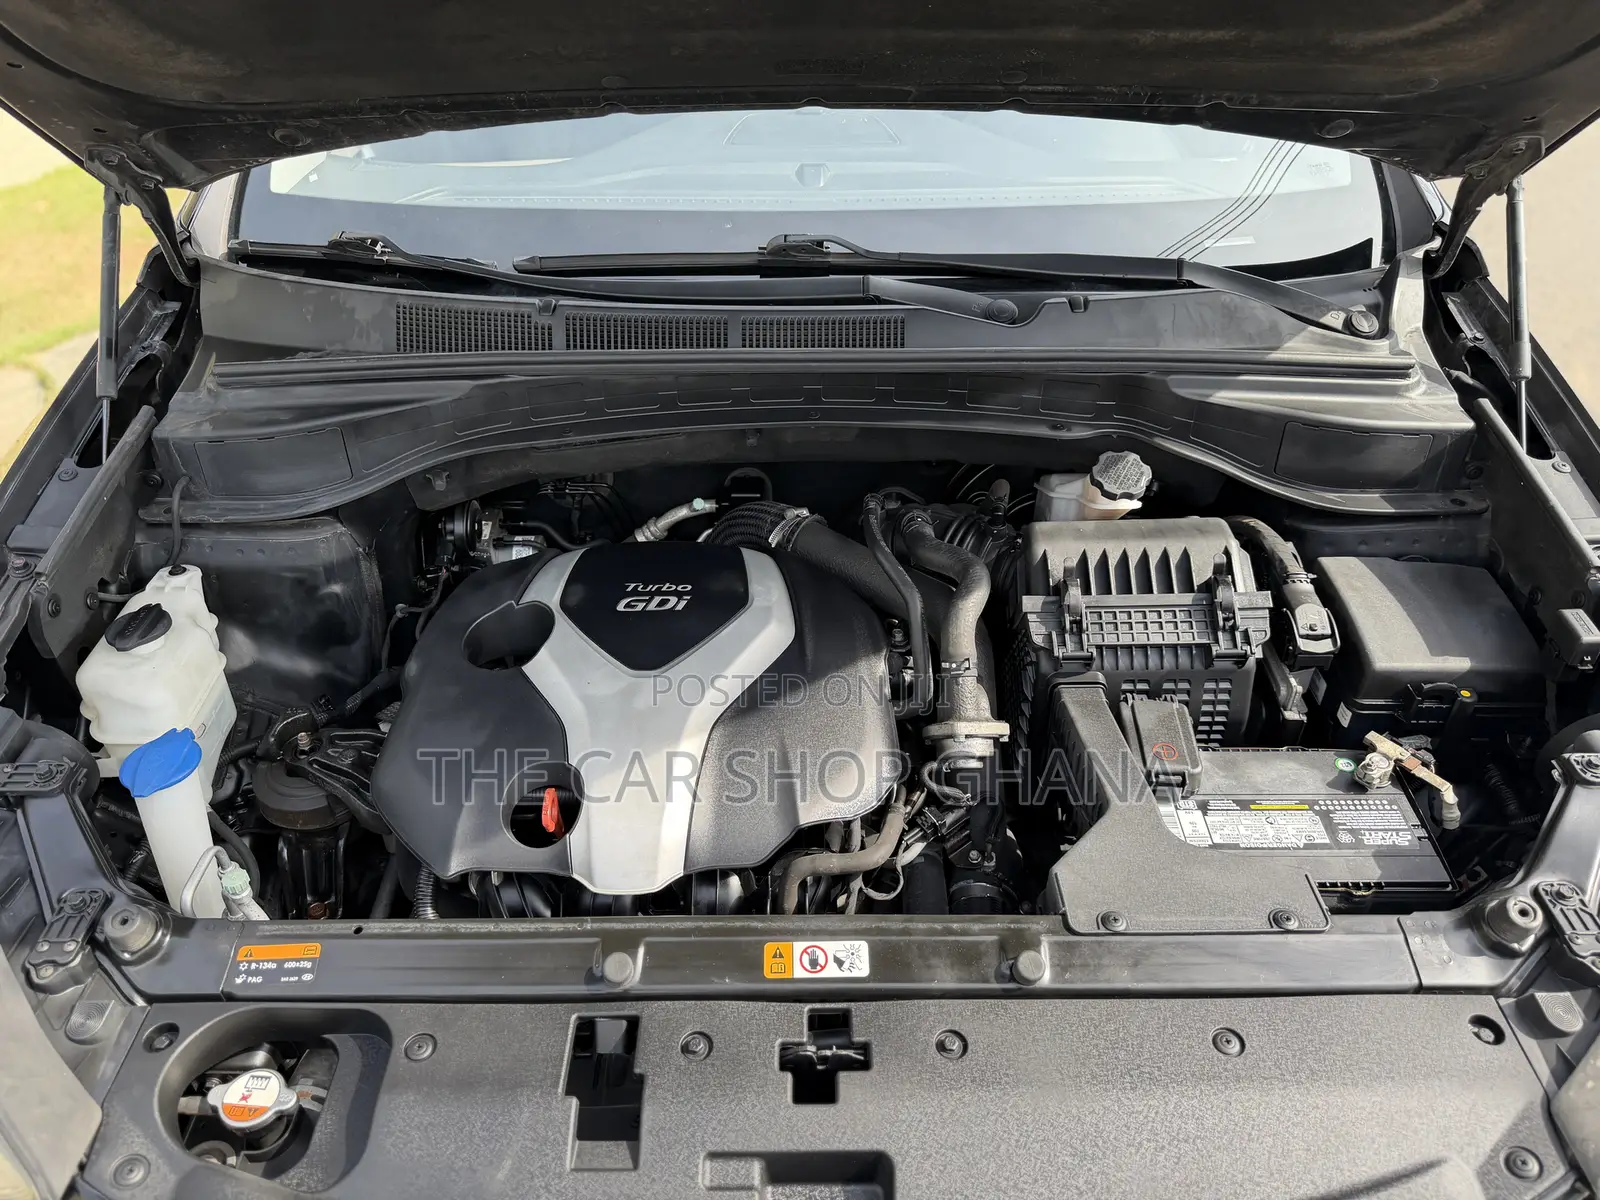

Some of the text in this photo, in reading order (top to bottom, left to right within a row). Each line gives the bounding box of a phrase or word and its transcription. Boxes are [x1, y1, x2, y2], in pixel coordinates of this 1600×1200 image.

[624, 582, 693, 592] Turbo
[616, 595, 692, 612] GDi
[250, 962, 277, 970] R-134a
[247, 975, 263, 984] PAG
